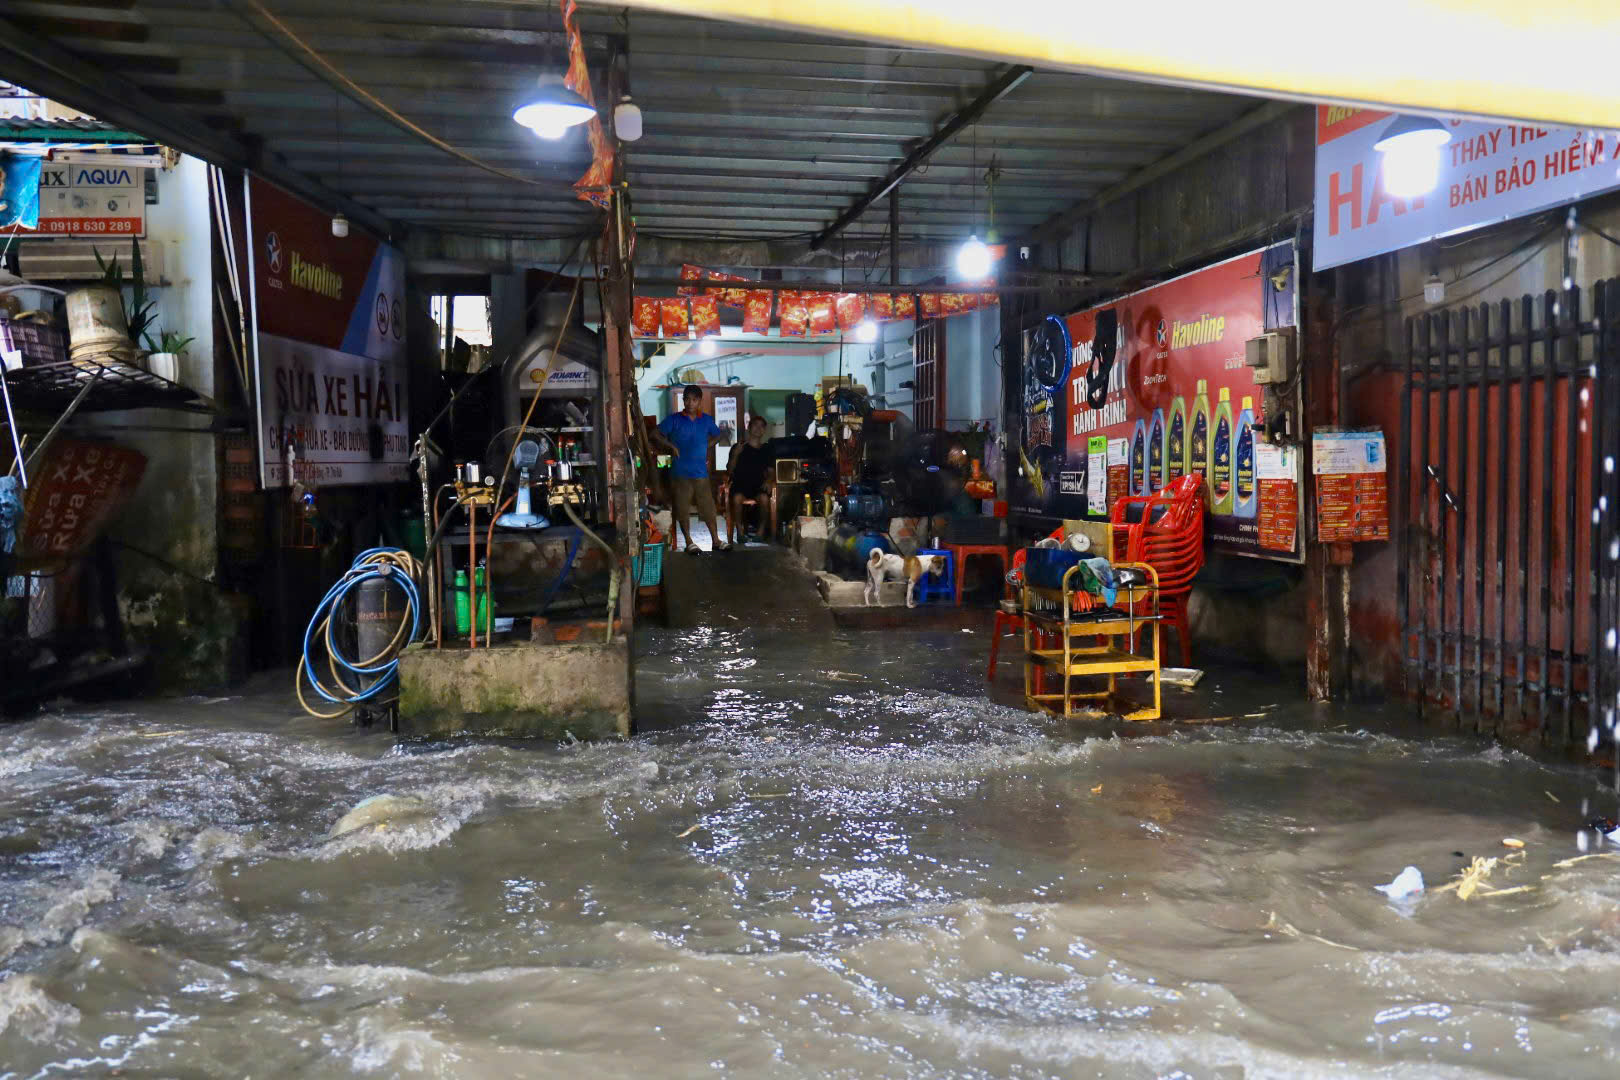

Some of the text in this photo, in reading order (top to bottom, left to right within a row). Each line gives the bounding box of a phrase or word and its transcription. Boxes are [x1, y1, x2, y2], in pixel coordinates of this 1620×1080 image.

[1449, 128, 1502, 168] THAY
[77, 169, 132, 185] AQUA
[1449, 174, 1488, 208] BÁN
[1495, 156, 1537, 195] BẢO
[50, 221, 80, 232] 0918
[83, 221, 106, 232] 630
[109, 221, 132, 232] 289
[290, 250, 344, 301] Havoline
[1171, 313, 1225, 350] Havoline
[323, 375, 348, 416] XE
[1073, 408, 1097, 436] HÀNH
[1098, 398, 1127, 429] TRÌNH
